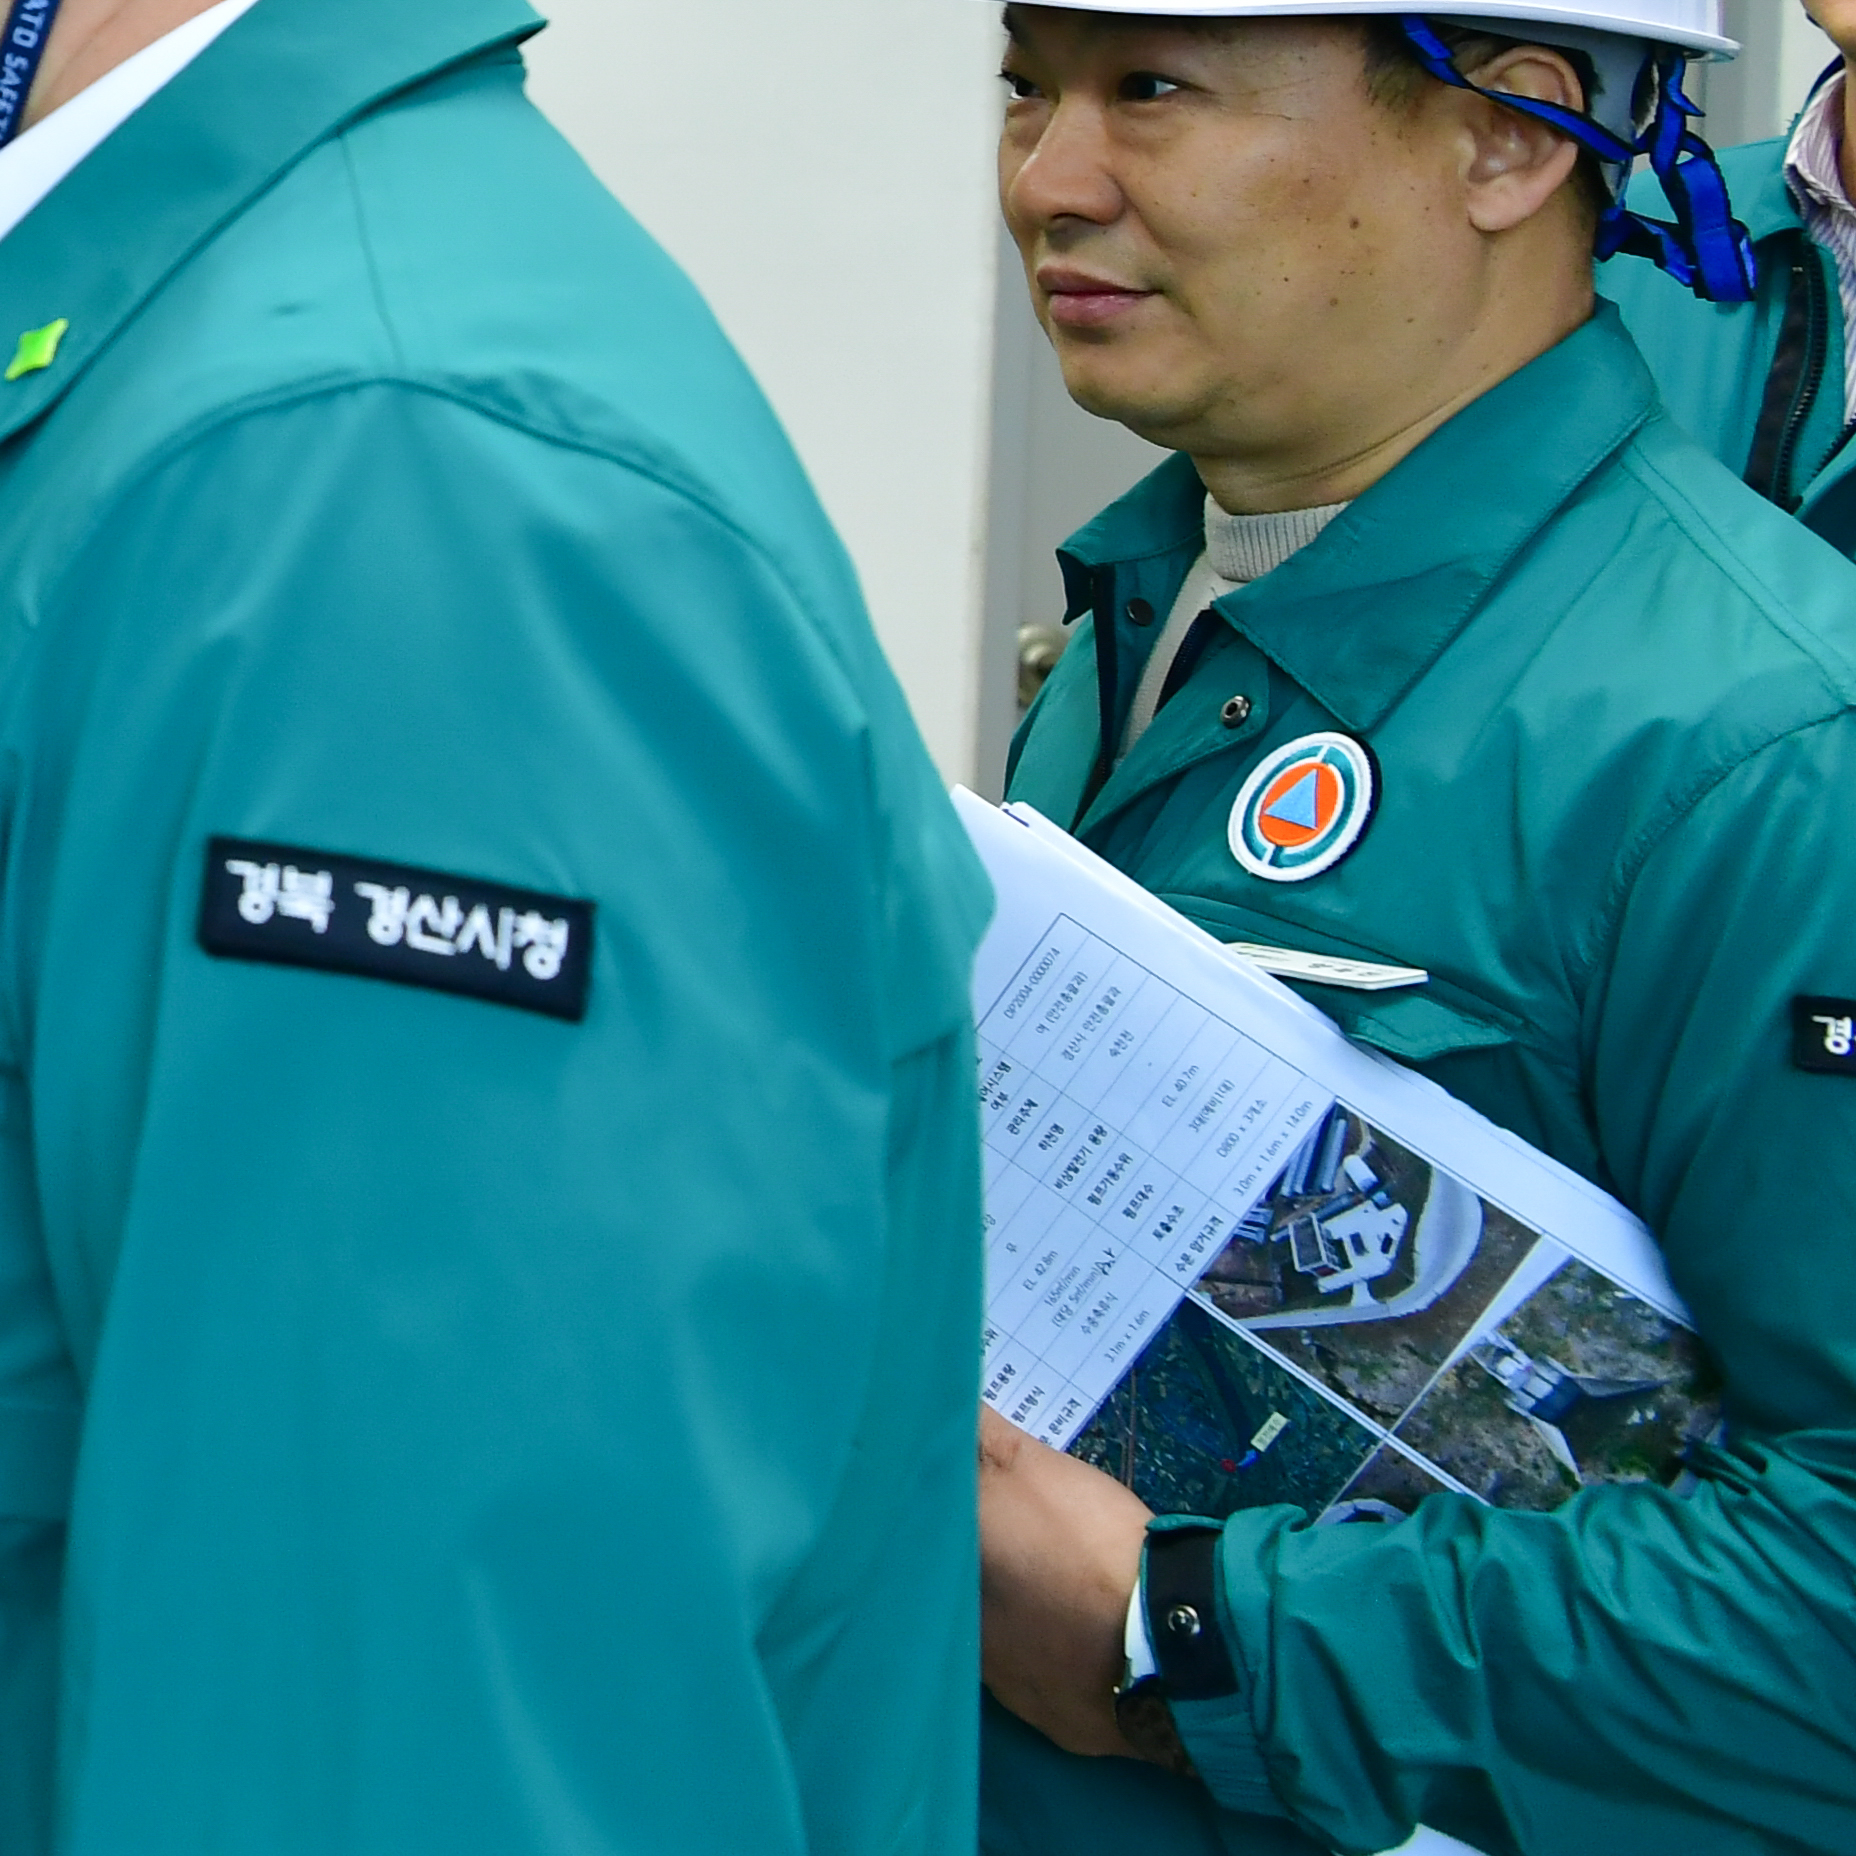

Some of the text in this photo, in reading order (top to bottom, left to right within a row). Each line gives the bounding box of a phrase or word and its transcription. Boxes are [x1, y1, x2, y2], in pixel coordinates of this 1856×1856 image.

[225, 858, 568, 980] 경북 경산시청
[1061, 984, 1123, 1062] 경산시 안전총괄과
[1812, 1015, 1856, 1055] 경
[1172, 1062, 1200, 1093] 40.7m
[1005, 1097, 1039, 1136] 관리주체
[1037, 1122, 1066, 1153] 하천명
[1052, 1123, 1109, 1192] 비상발전기 용량
[1086, 1151, 1133, 1207] 펌프가동수위
[1122, 1180, 1157, 1220] 펌프대수
[1151, 1202, 1186, 1242] 토출수조
[1173, 1252, 1195, 1275] 수문
[982, 1362, 1017, 1402] 펌프용량
[1010, 1384, 1045, 1424] 펌프형식
